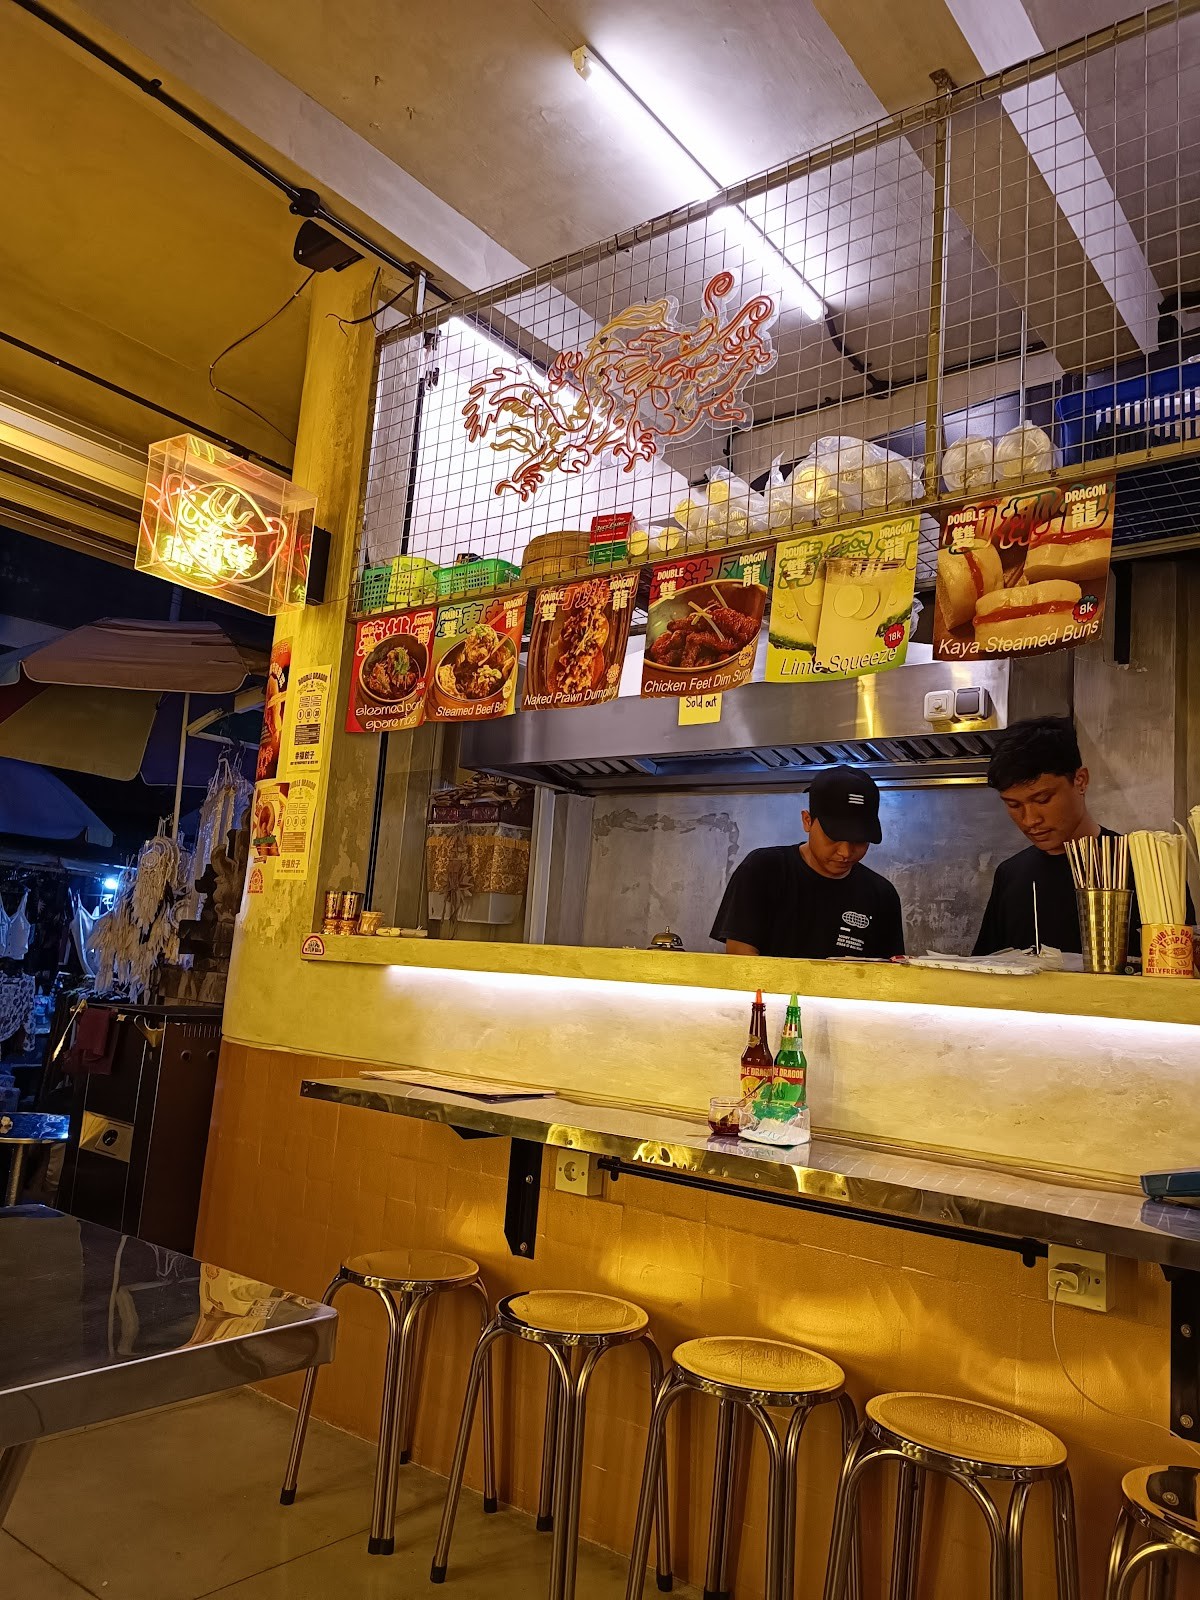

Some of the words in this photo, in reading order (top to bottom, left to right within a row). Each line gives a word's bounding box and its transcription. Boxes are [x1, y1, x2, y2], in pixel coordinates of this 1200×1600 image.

[947, 509, 985, 526] DOUBLE
[1064, 484, 1107, 503] DRAGON
[1071, 500, 1099, 529] 龍
[783, 544, 815, 557] DOUBLE
[879, 522, 913, 539] DRAGON
[951, 525, 976, 550] 雙
[884, 537, 906, 562] 龍
[657, 567, 685, 581] DOUBLE
[739, 551, 767, 566] DRAGON
[743, 564, 761, 587] 龍
[540, 591, 564, 602] DOUBLE
[610, 577, 635, 590] DRAGON
[612, 590, 629, 611] 龍
[1079, 601, 1094, 615] 8k
[506, 609, 519, 629] 龍
[888, 630, 902, 641] 18k
[938, 638, 980, 658] Kaya
[985, 627, 1058, 653] Steamed
[1062, 619, 1099, 642] Buns
[780, 654, 823, 676] Lime
[829, 647, 898, 675] Squeeze
[644, 680, 687, 693] Chicken
[689, 676, 713, 690] Feet
[713, 673, 732, 688] Dim
[355, 700, 404, 716] steamed
[405, 697, 425, 717] pork
[524, 692, 554, 706] Naked
[555, 690, 583, 703] Prawn
[685, 694, 703, 708] Sold
[705, 696, 717, 708] out
[436, 704, 474, 717] Steamed
[475, 702, 495, 715] Beef
[365, 719, 399, 732] spare
[1150, 928, 1176, 948] DOUBLE
[1159, 936, 1189, 948] TEMPLE
[779, 1068, 804, 1079] DRAGON
